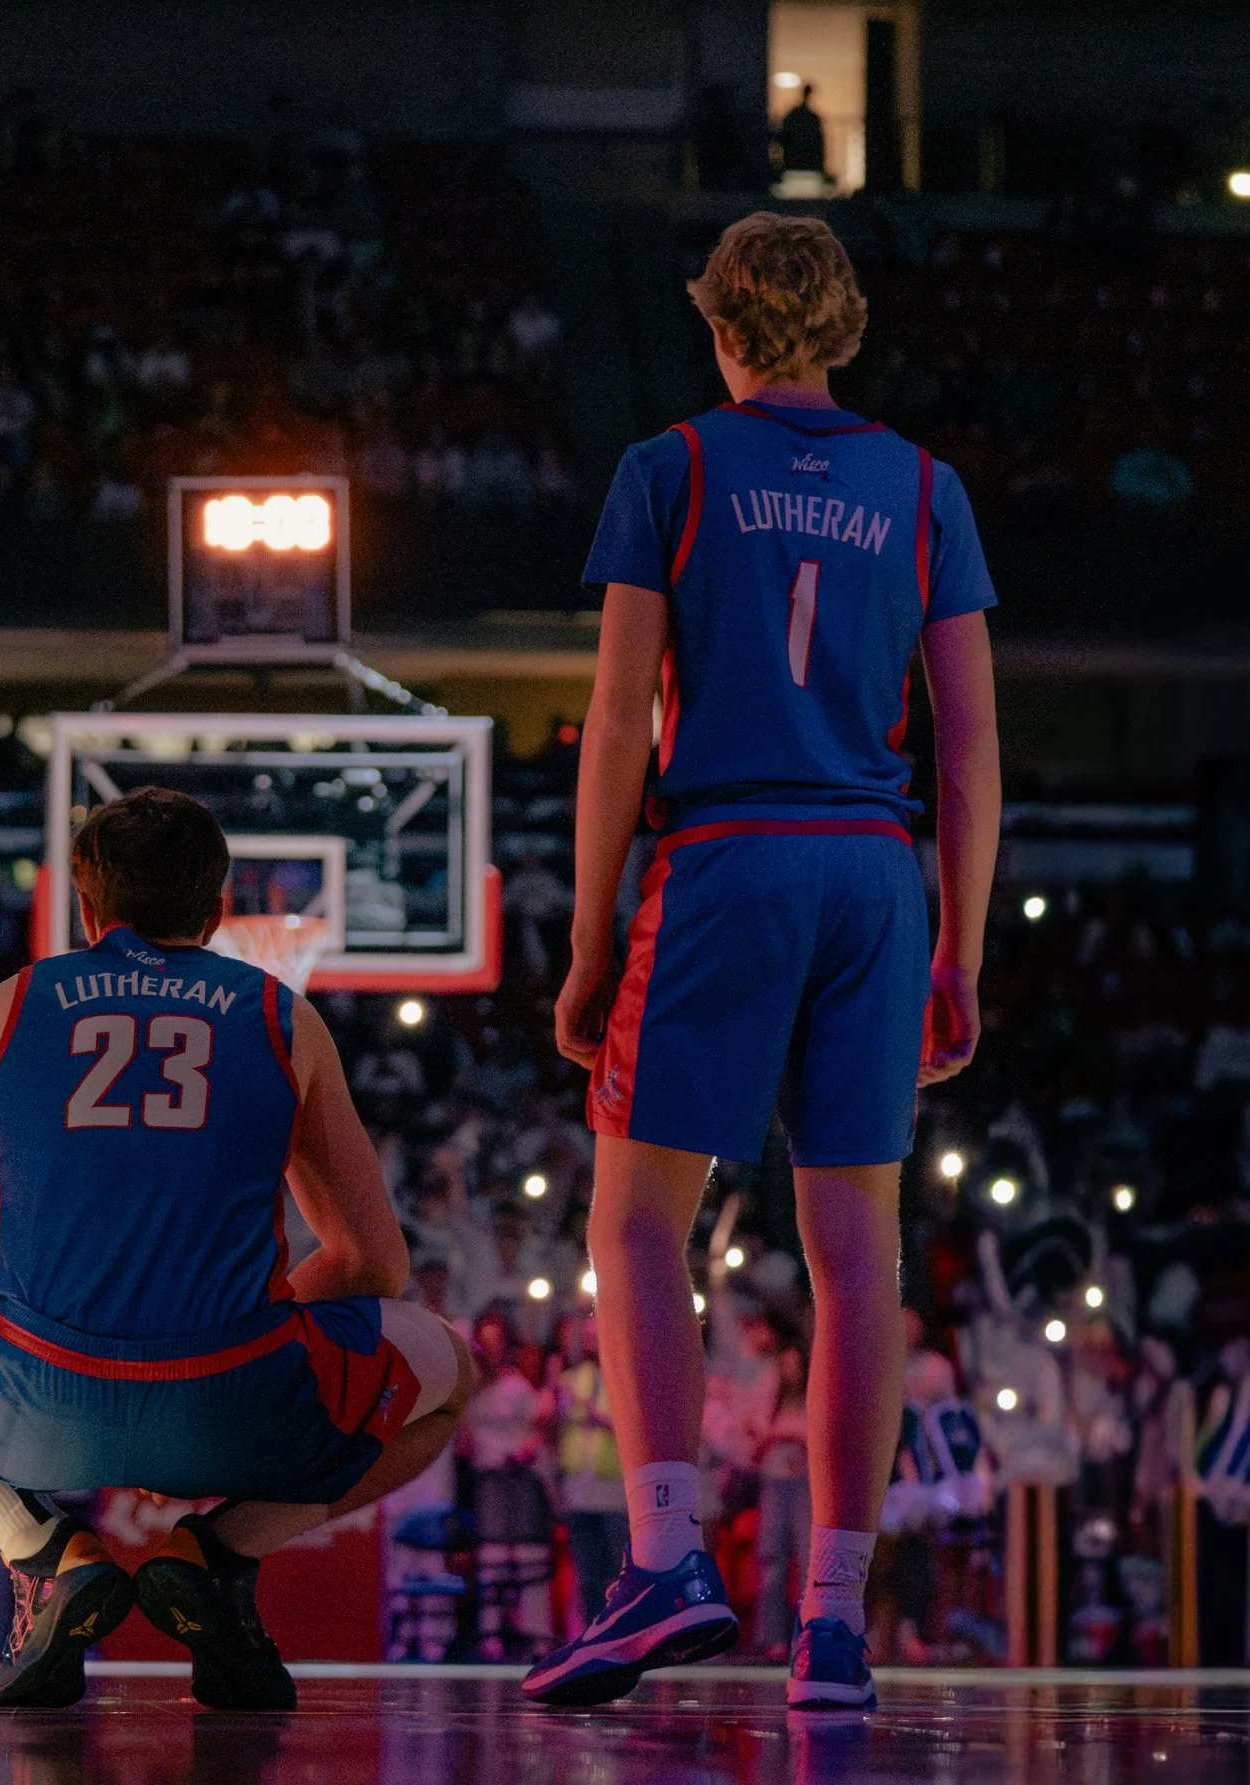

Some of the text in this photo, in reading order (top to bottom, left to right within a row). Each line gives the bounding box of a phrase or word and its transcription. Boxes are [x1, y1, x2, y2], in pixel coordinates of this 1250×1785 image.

[731, 489, 892, 555] LUTHERAN
[787, 559, 821, 689] 1
[54, 970, 237, 1016] LUTHERAN
[63, 1012, 214, 1131] 23
